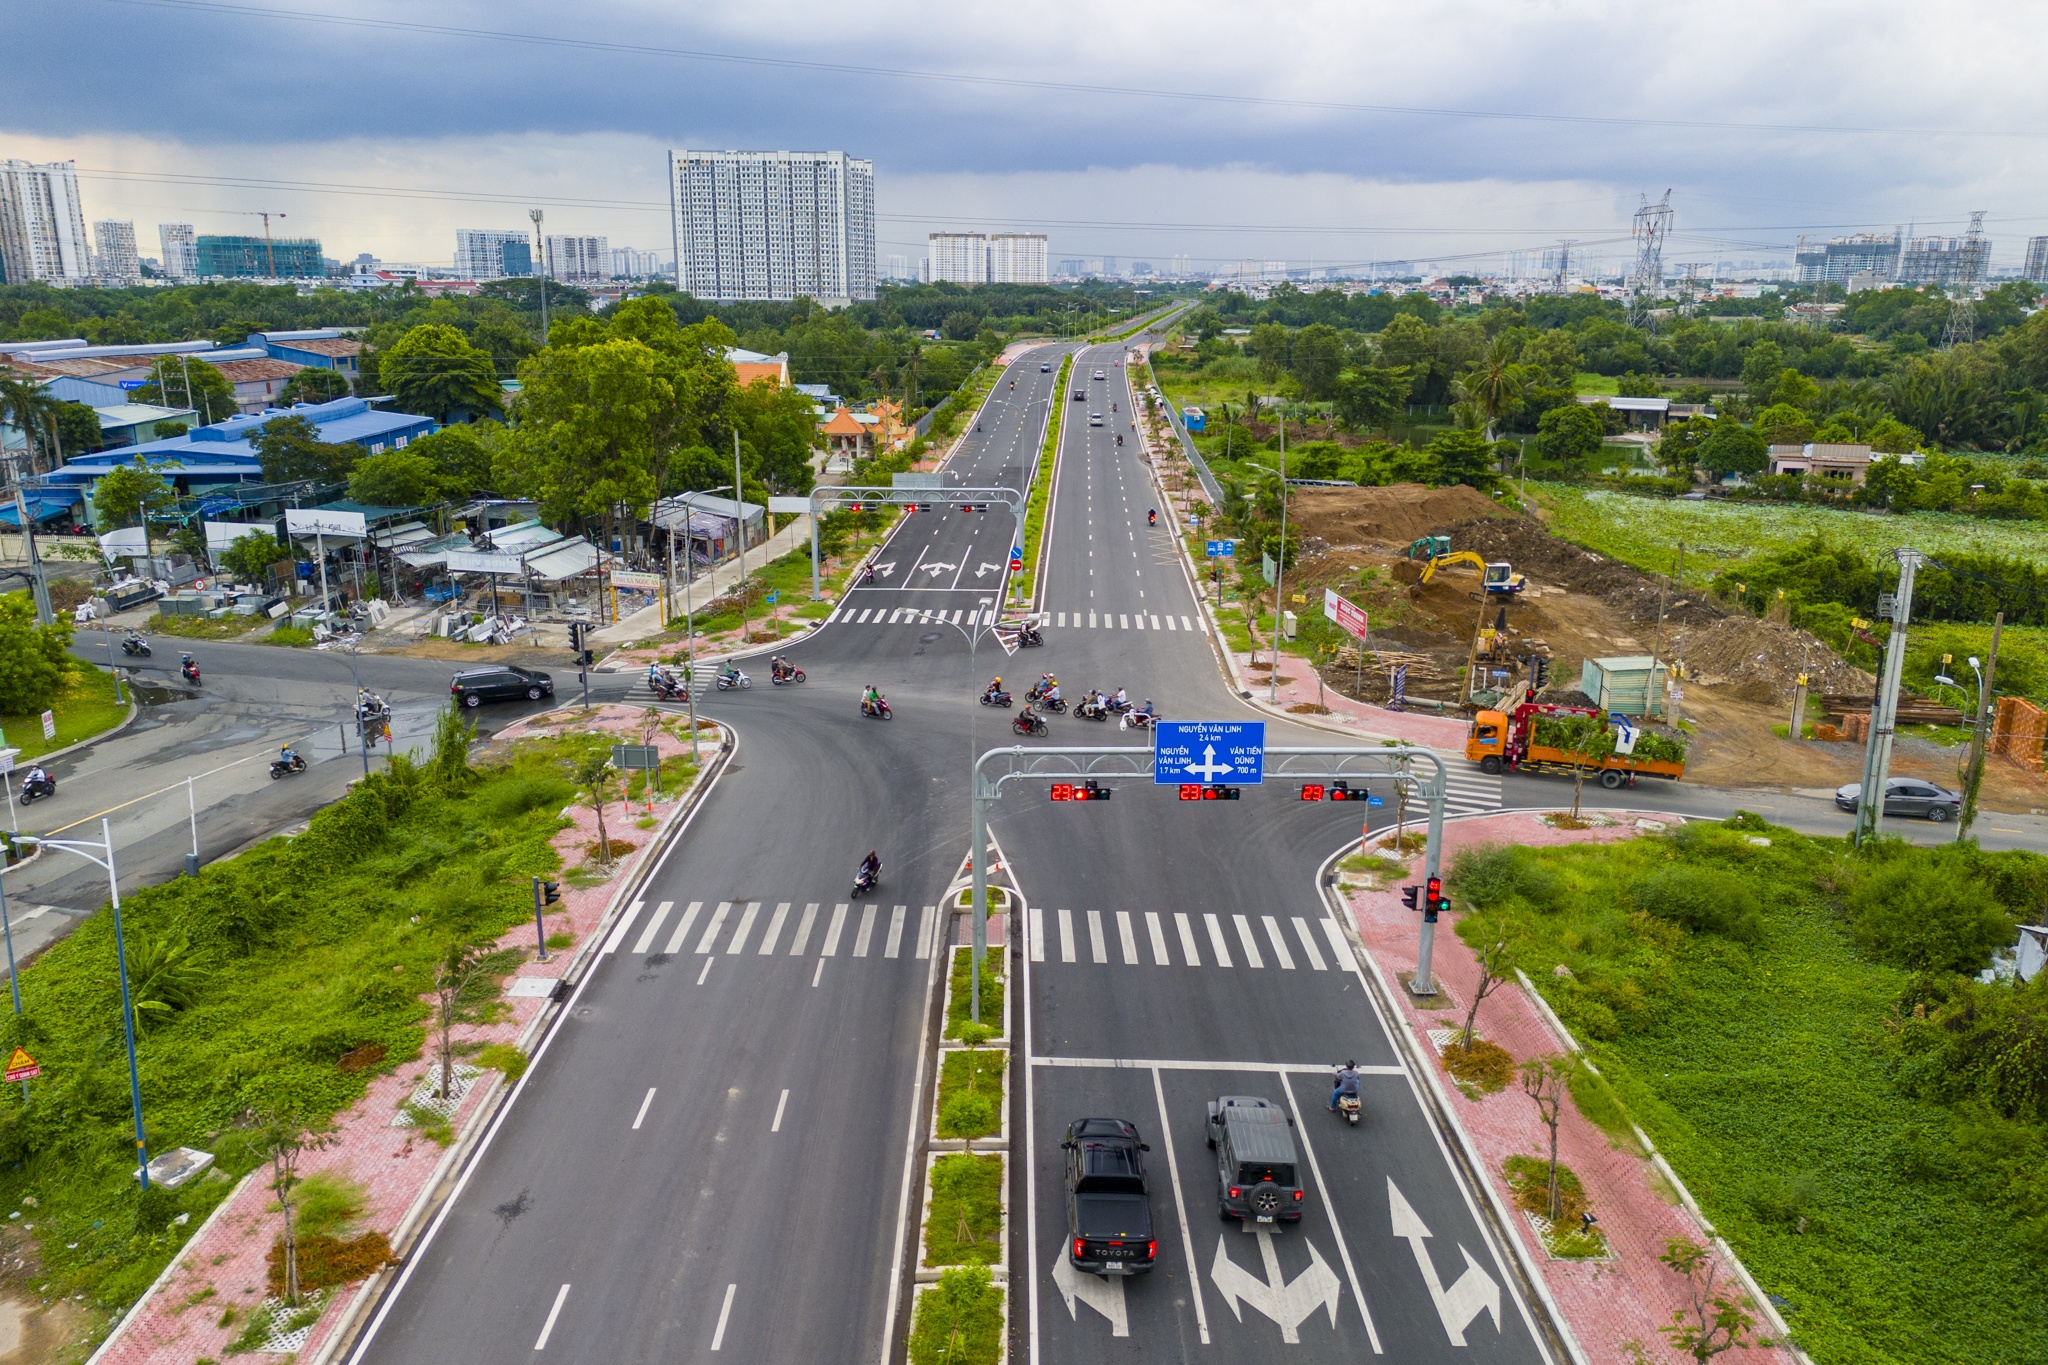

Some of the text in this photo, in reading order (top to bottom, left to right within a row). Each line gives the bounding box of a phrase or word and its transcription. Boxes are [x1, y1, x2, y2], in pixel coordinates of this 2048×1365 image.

[1178, 722, 1207, 733] NGUYỄN
[1208, 724, 1224, 733] VĂN
[1160, 745, 1189, 754] NGUYỄN
[1230, 746, 1262, 754] VĂN TIẾN
[1234, 756, 1255, 764] DŨNG
[1052, 786, 1070, 800] 23
[1180, 785, 1199, 800] 23
[1303, 786, 1322, 800] 23
